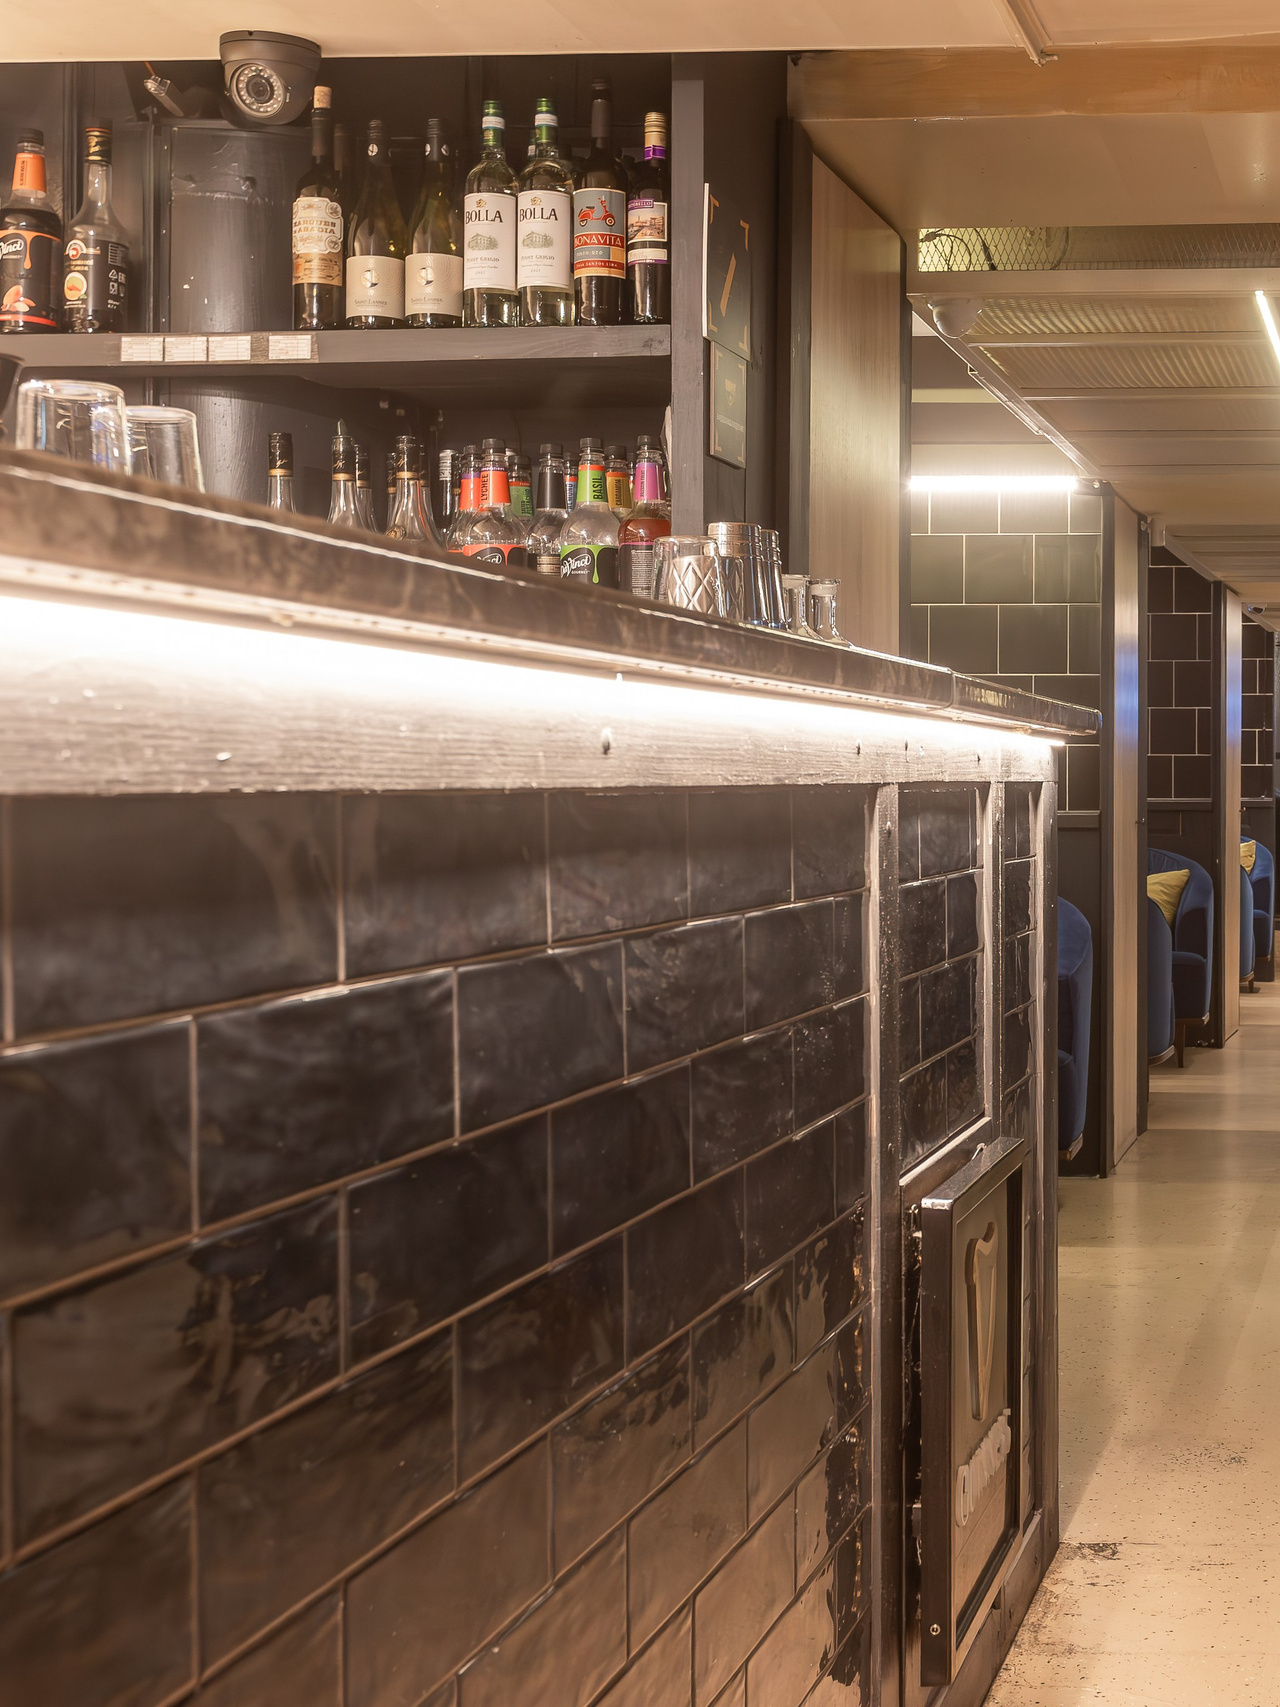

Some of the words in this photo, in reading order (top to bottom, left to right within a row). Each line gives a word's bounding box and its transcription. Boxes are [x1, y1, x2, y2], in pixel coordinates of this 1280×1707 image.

[465, 209, 503, 225] BOLLA
[520, 207, 558, 223] BOLLA
[480, 473, 489, 501] LYCHEE
[592, 476, 603, 500] BASIL
[561, 554, 591, 578] DaVinci
